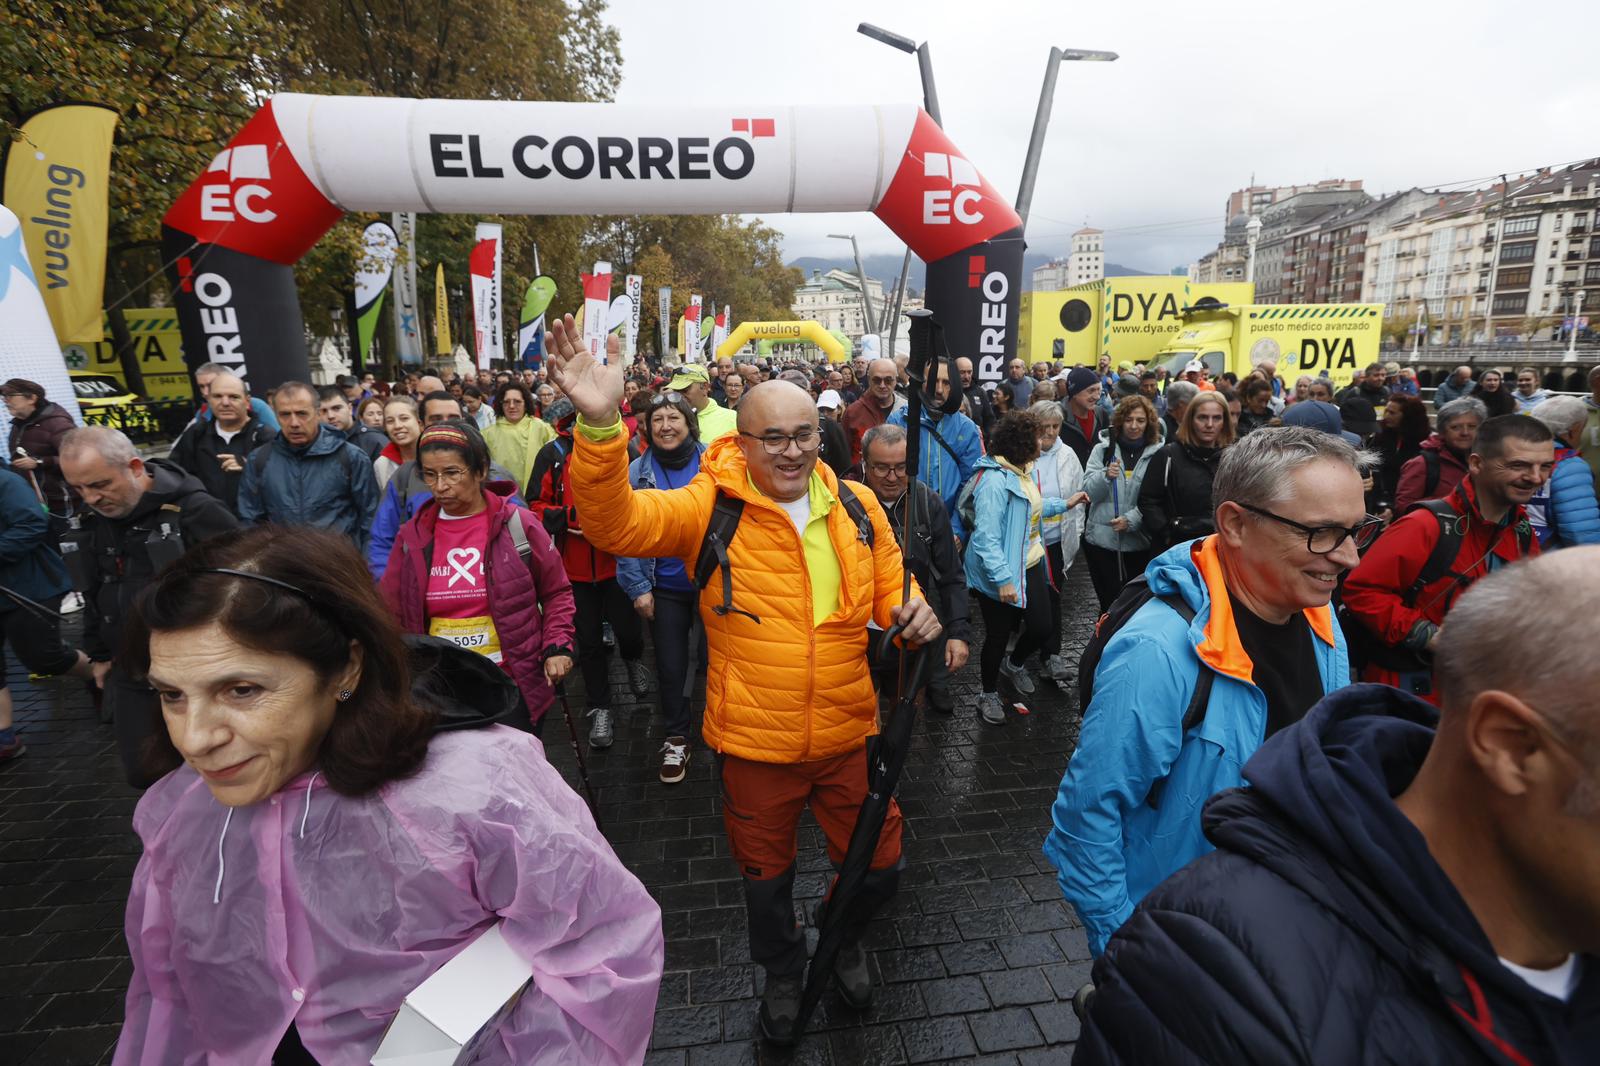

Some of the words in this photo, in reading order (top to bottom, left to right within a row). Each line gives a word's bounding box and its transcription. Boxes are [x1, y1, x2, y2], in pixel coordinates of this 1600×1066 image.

[429, 133, 504, 178] EL
[511, 135, 755, 180] CORREO
[201, 184, 278, 223] EC
[923, 189, 985, 225] EC
[32, 163, 86, 290] vueling
[1112, 292, 1179, 322] DYA
[753, 323, 801, 336] vueling
[1112, 323, 1181, 336] www.dya.es
[1250, 323, 1285, 334] puesto
[1325, 321, 1370, 331] avanzado
[1299, 337, 1357, 370] DYA
[454, 634, 485, 647] 5057
